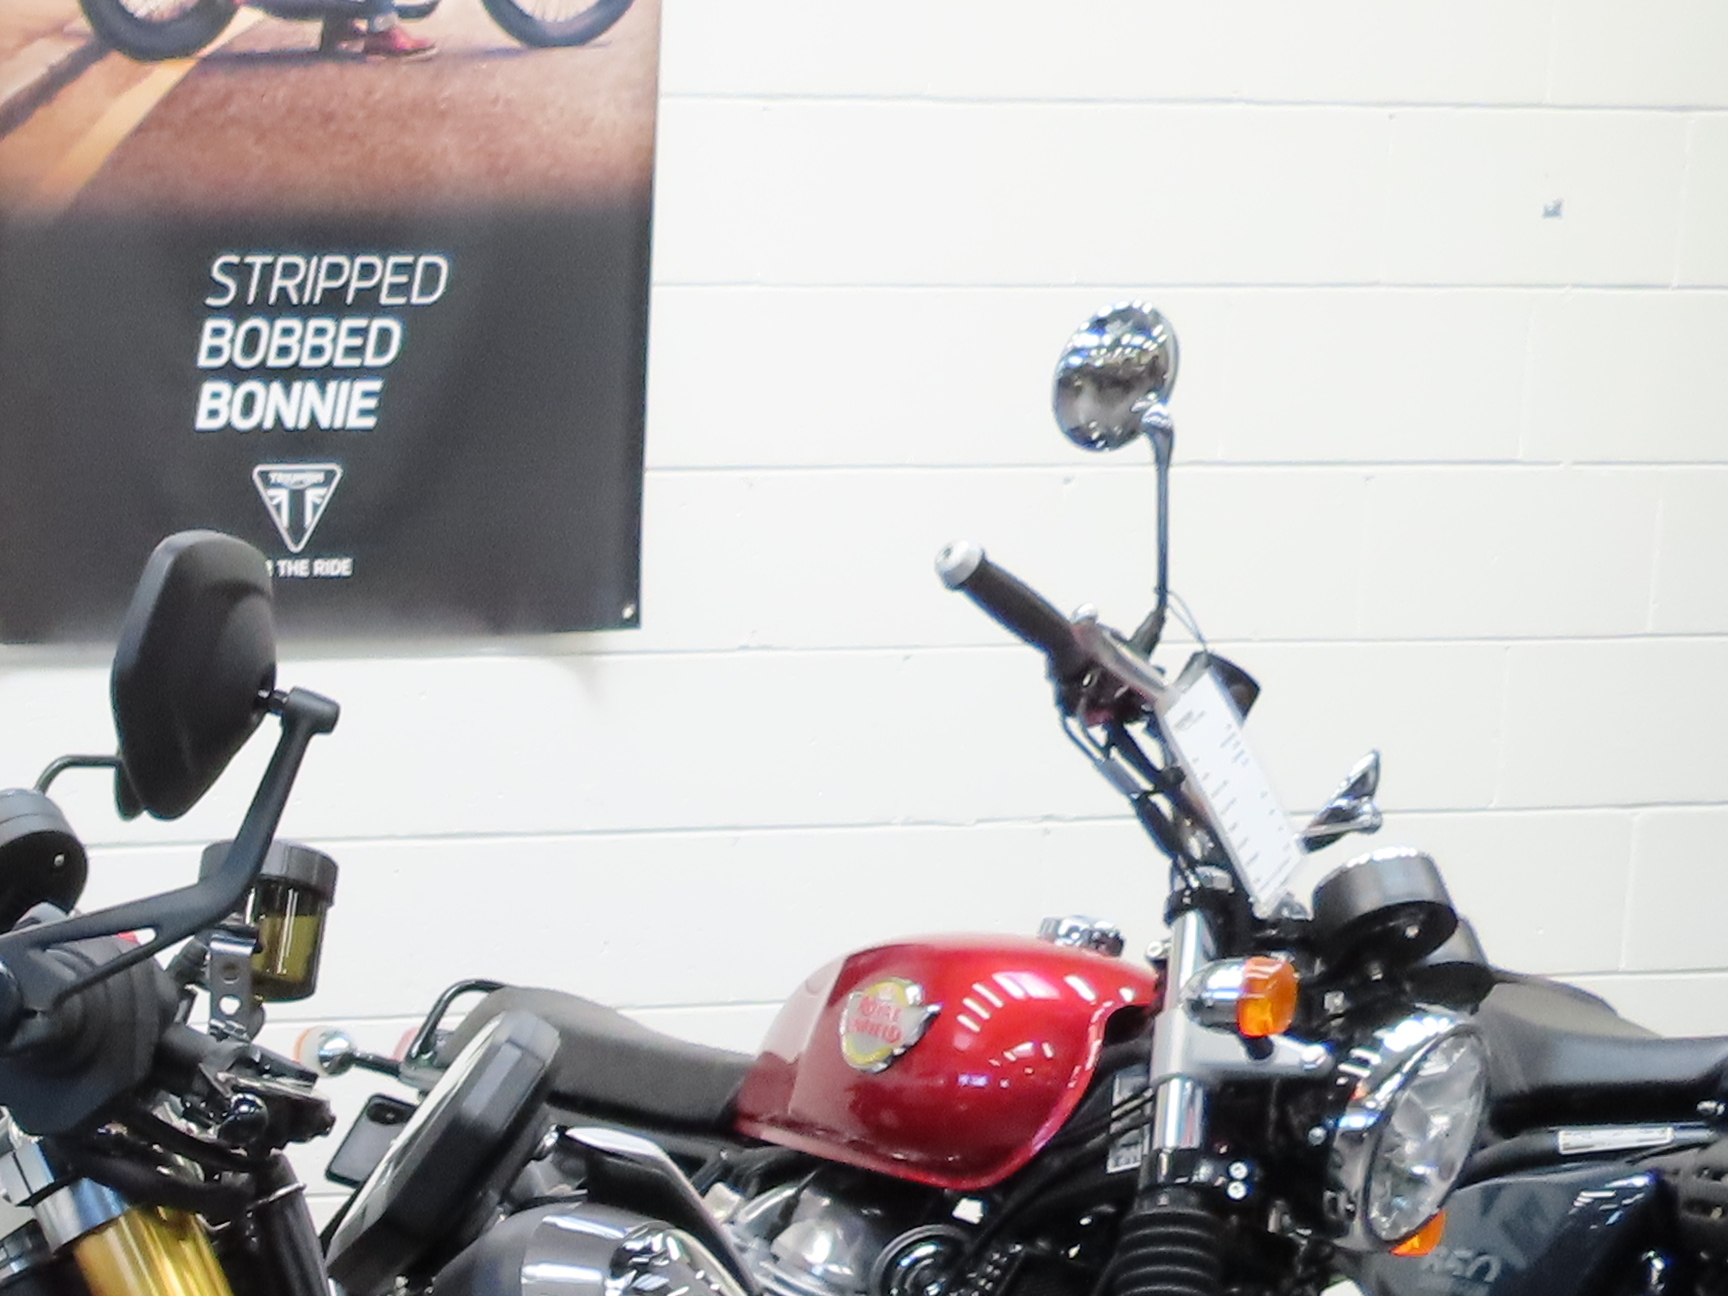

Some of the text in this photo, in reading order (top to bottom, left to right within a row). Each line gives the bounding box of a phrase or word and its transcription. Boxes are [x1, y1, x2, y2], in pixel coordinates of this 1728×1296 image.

[204, 254, 448, 306] STRIPPED
[196, 317, 402, 369] BOBBED
[195, 379, 383, 431] BONNIE
[276, 558, 310, 577] THE
[313, 557, 353, 577] RIDE
